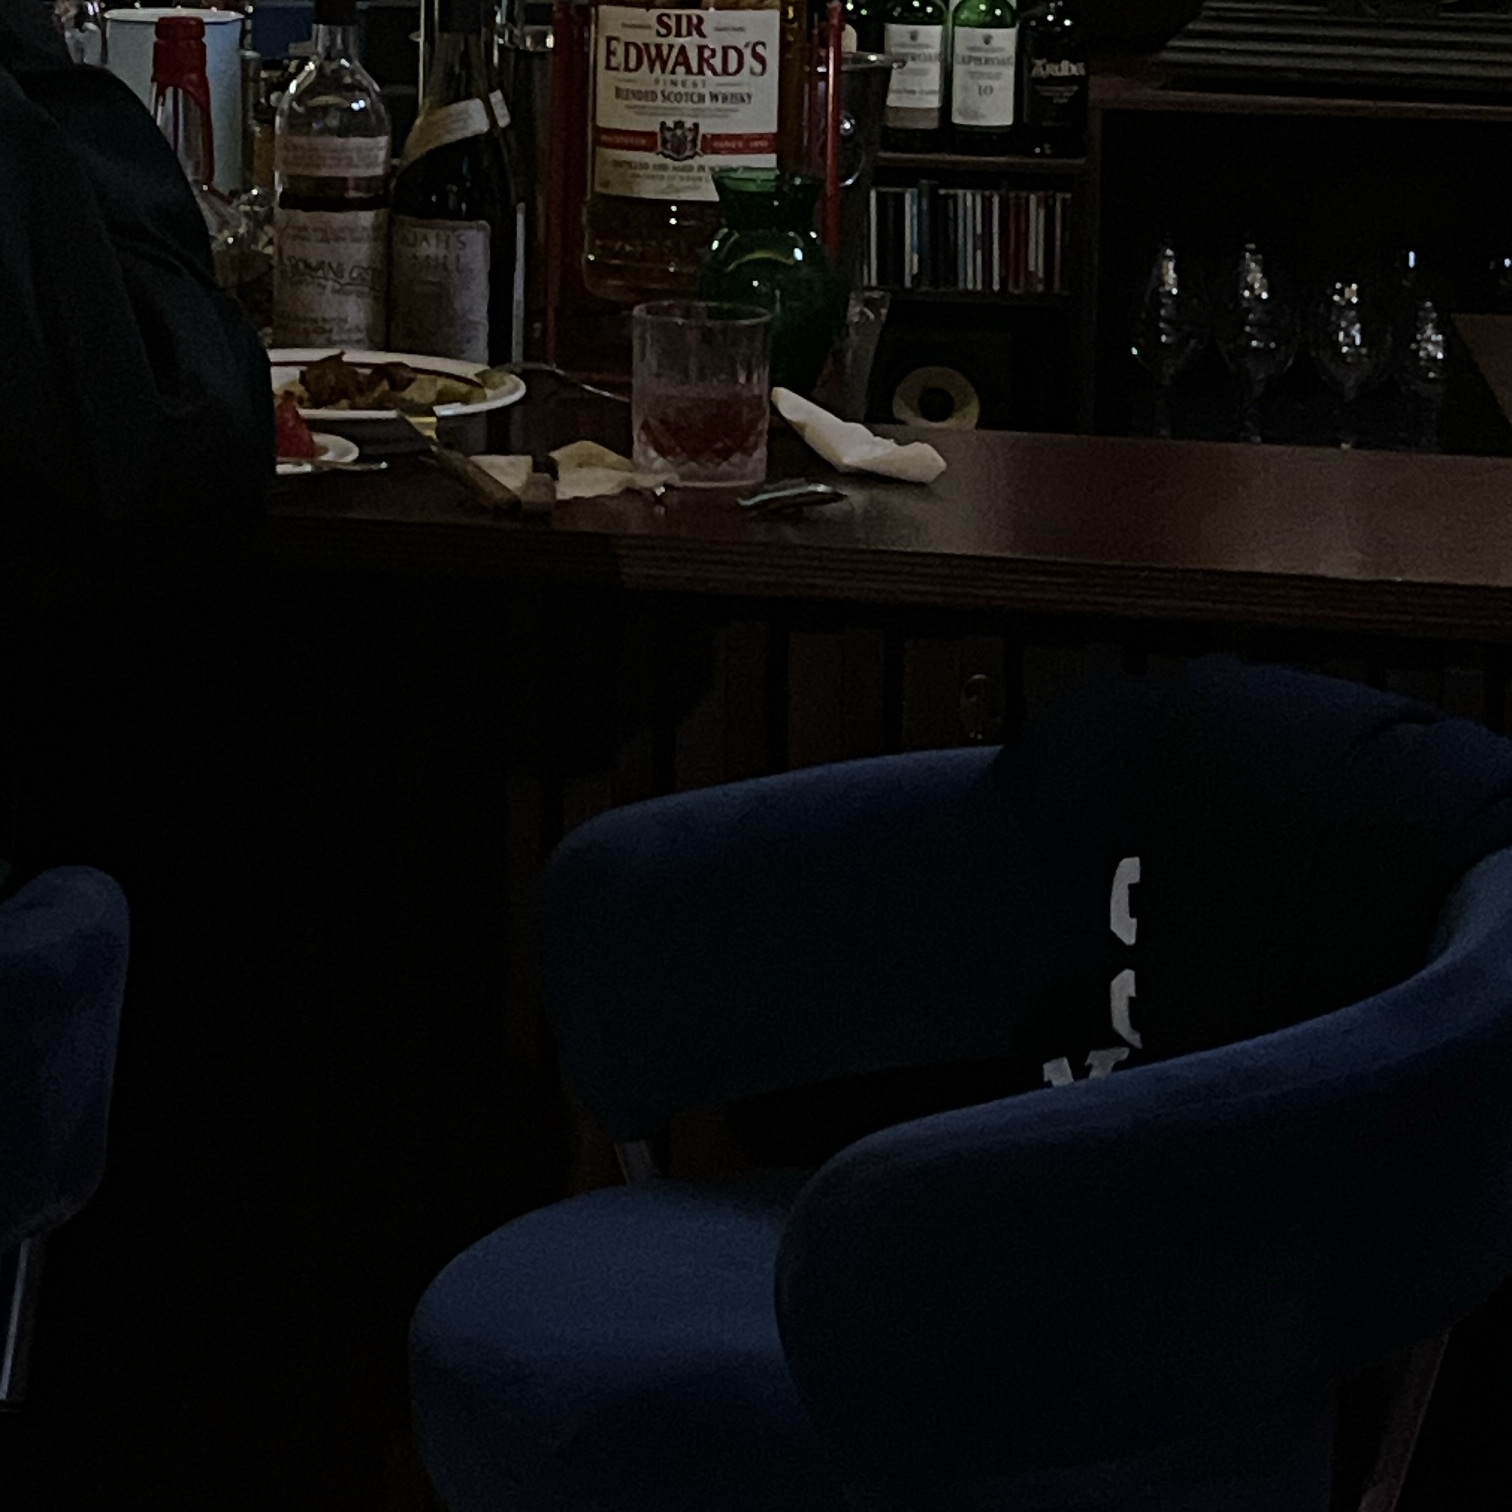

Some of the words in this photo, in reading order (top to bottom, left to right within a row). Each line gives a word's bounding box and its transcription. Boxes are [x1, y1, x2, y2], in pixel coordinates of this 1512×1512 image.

[655, 13, 708, 39] SIR
[604, 35, 768, 77] EDWARD'S
[977, 84, 995, 97] 10
